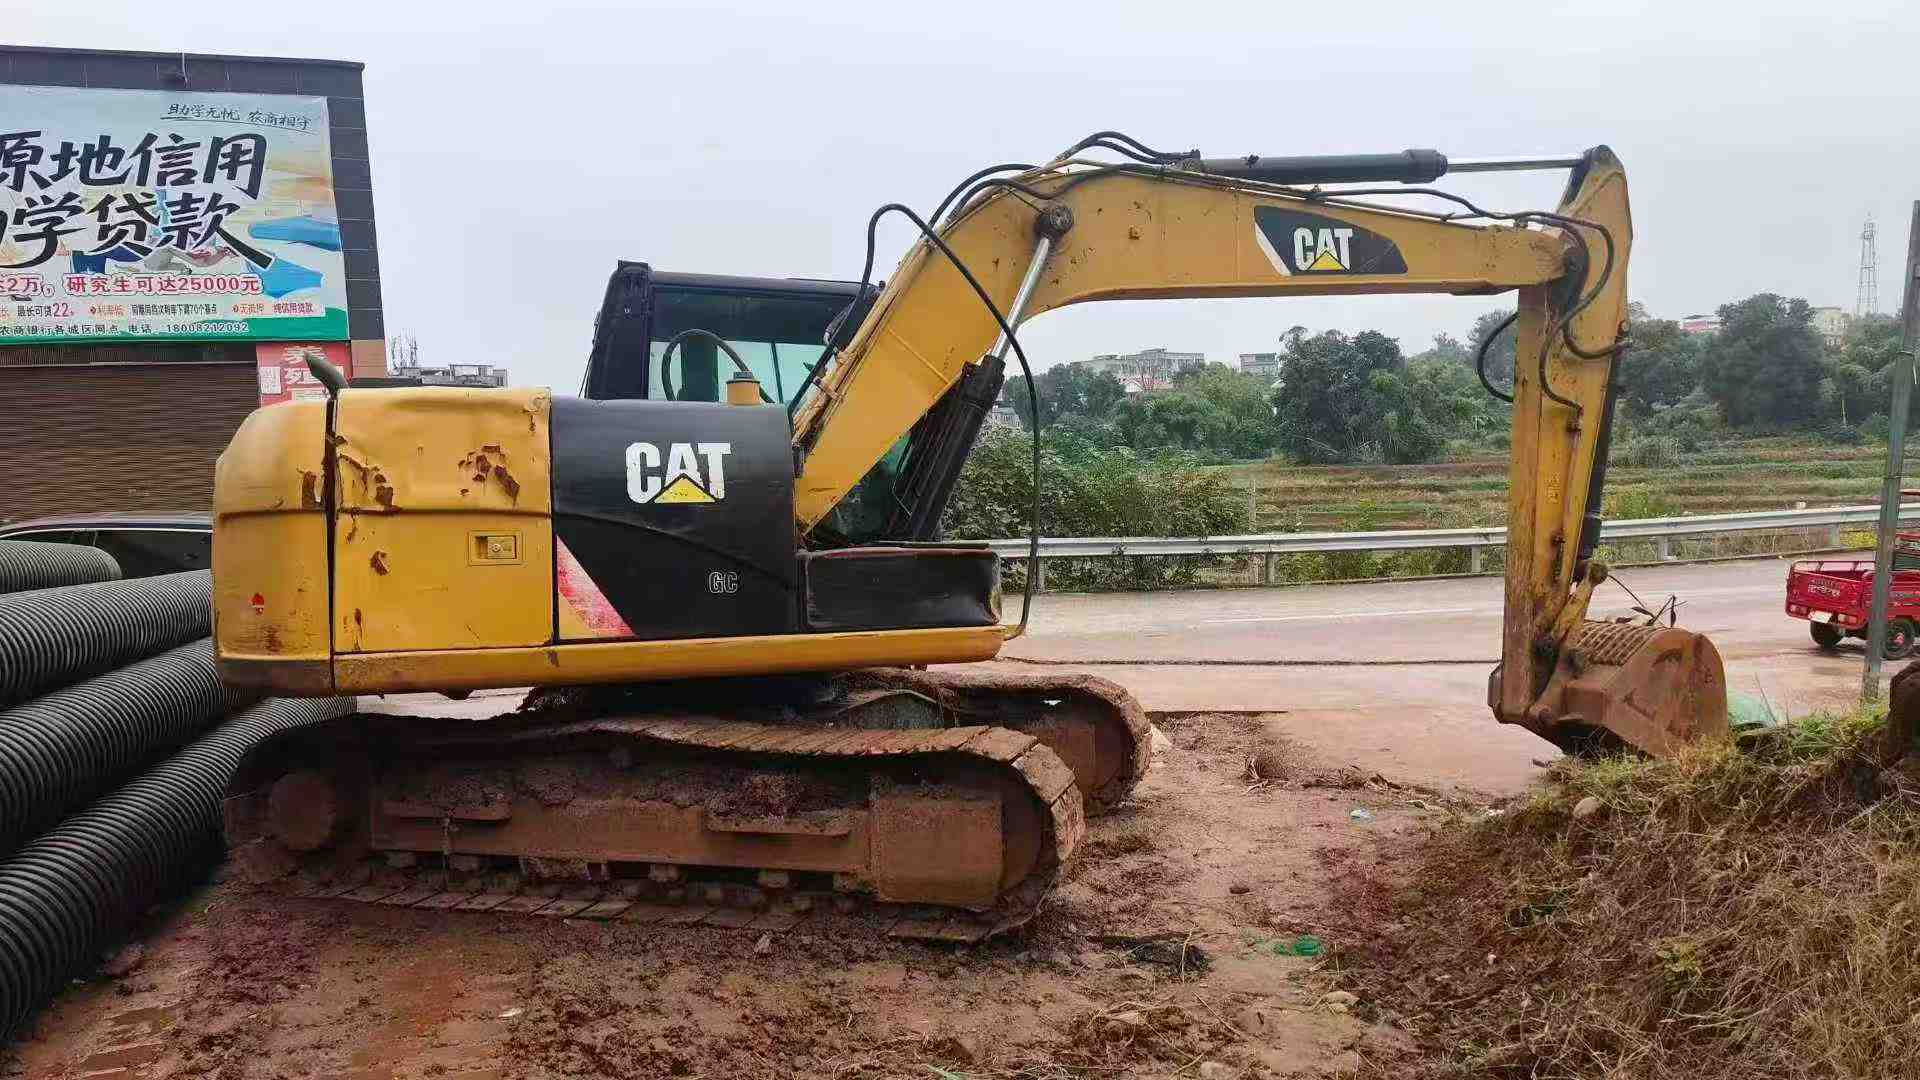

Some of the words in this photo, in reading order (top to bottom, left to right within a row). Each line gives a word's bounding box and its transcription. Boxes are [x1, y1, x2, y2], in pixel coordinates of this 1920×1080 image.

[0, 191, 275, 270] 学贷款
[1293, 227, 1353, 272] CAT
[625, 442, 732, 504] CAT
[708, 571, 739, 594] GC
